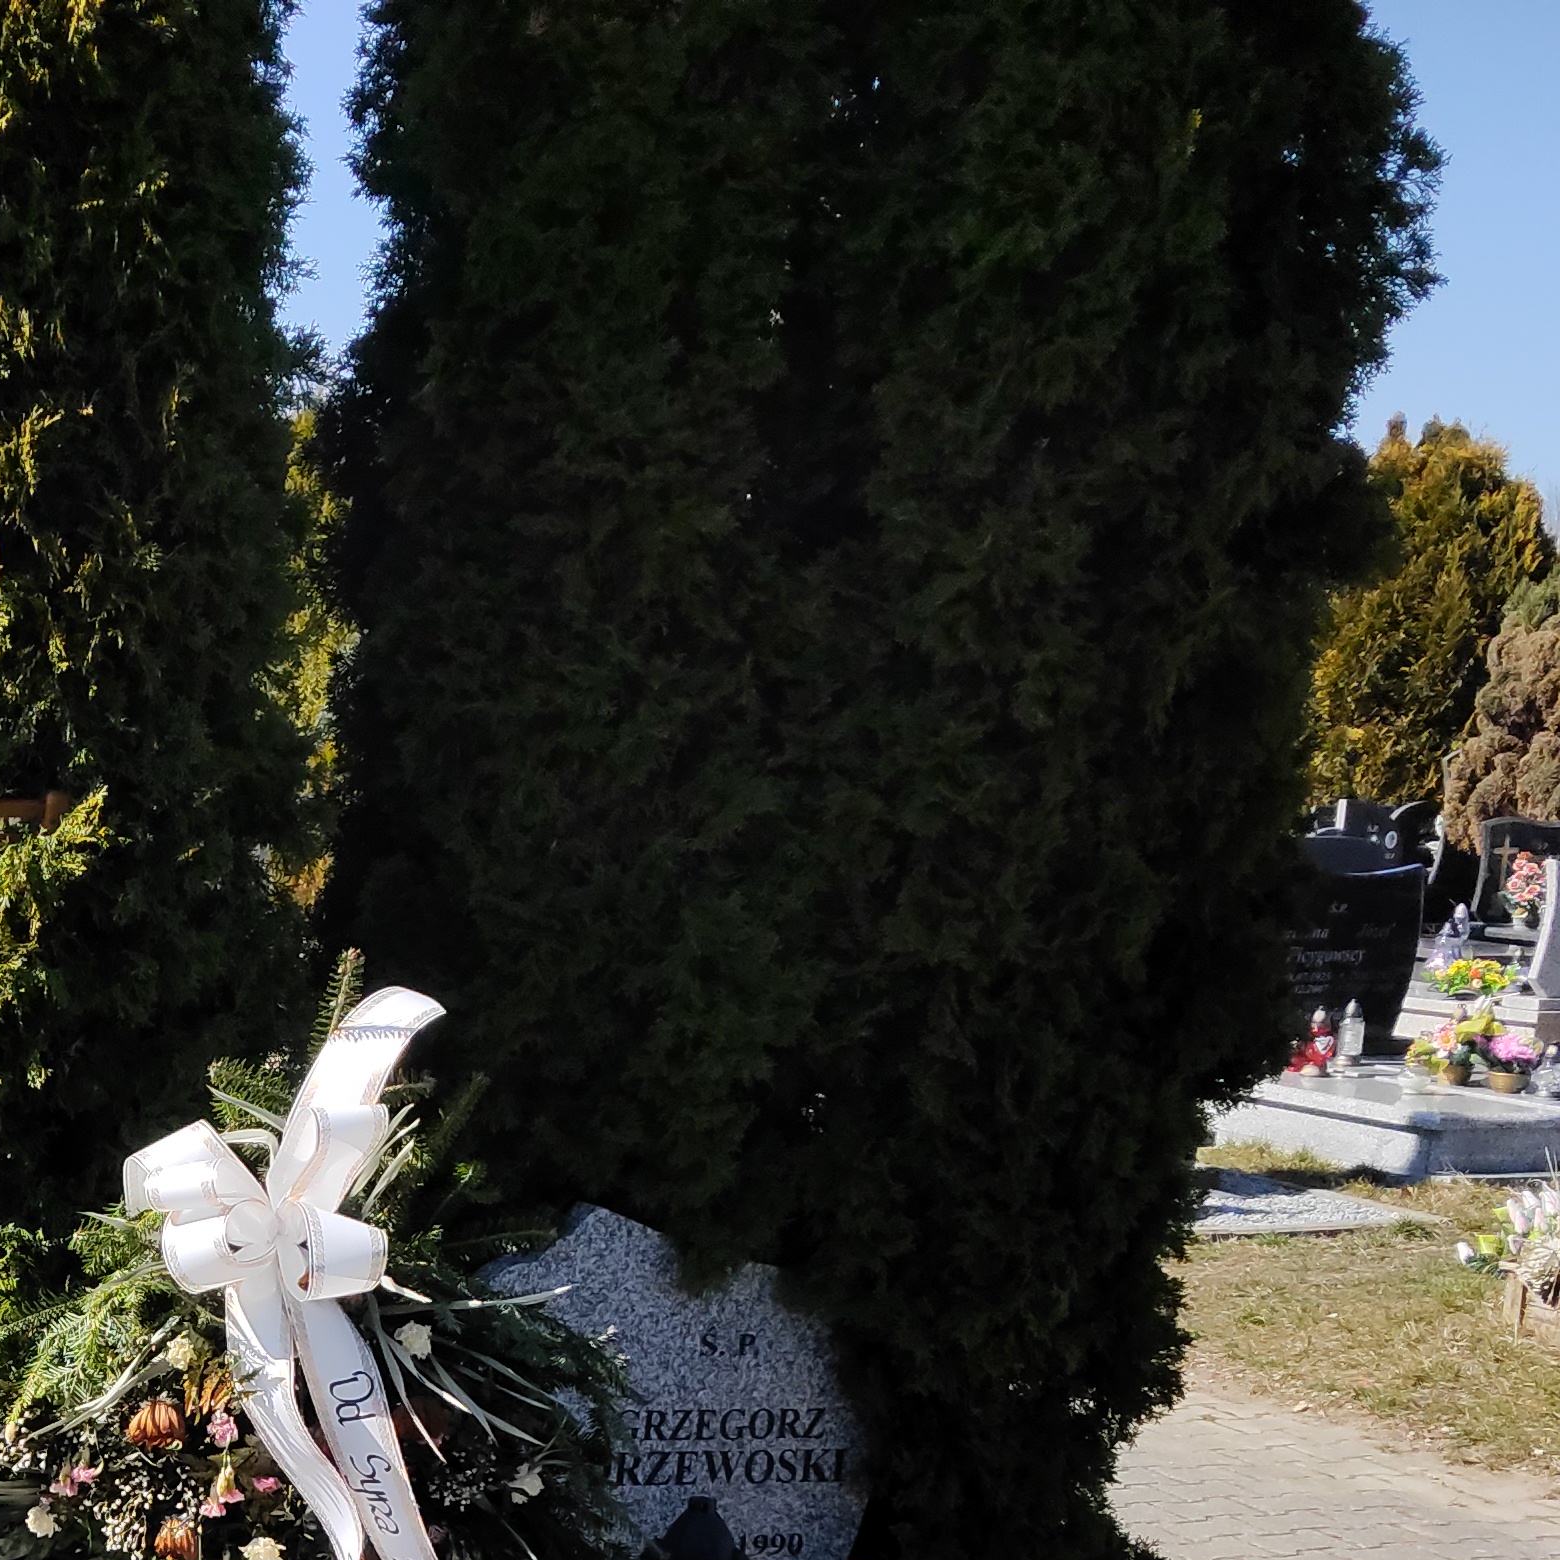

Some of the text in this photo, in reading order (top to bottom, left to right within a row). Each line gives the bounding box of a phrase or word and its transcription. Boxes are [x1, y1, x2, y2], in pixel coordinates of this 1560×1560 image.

[328, 1367, 376, 1428] Od
[342, 1453, 402, 1537] Syna
[602, 1448, 845, 1487] RZEWOSKI
